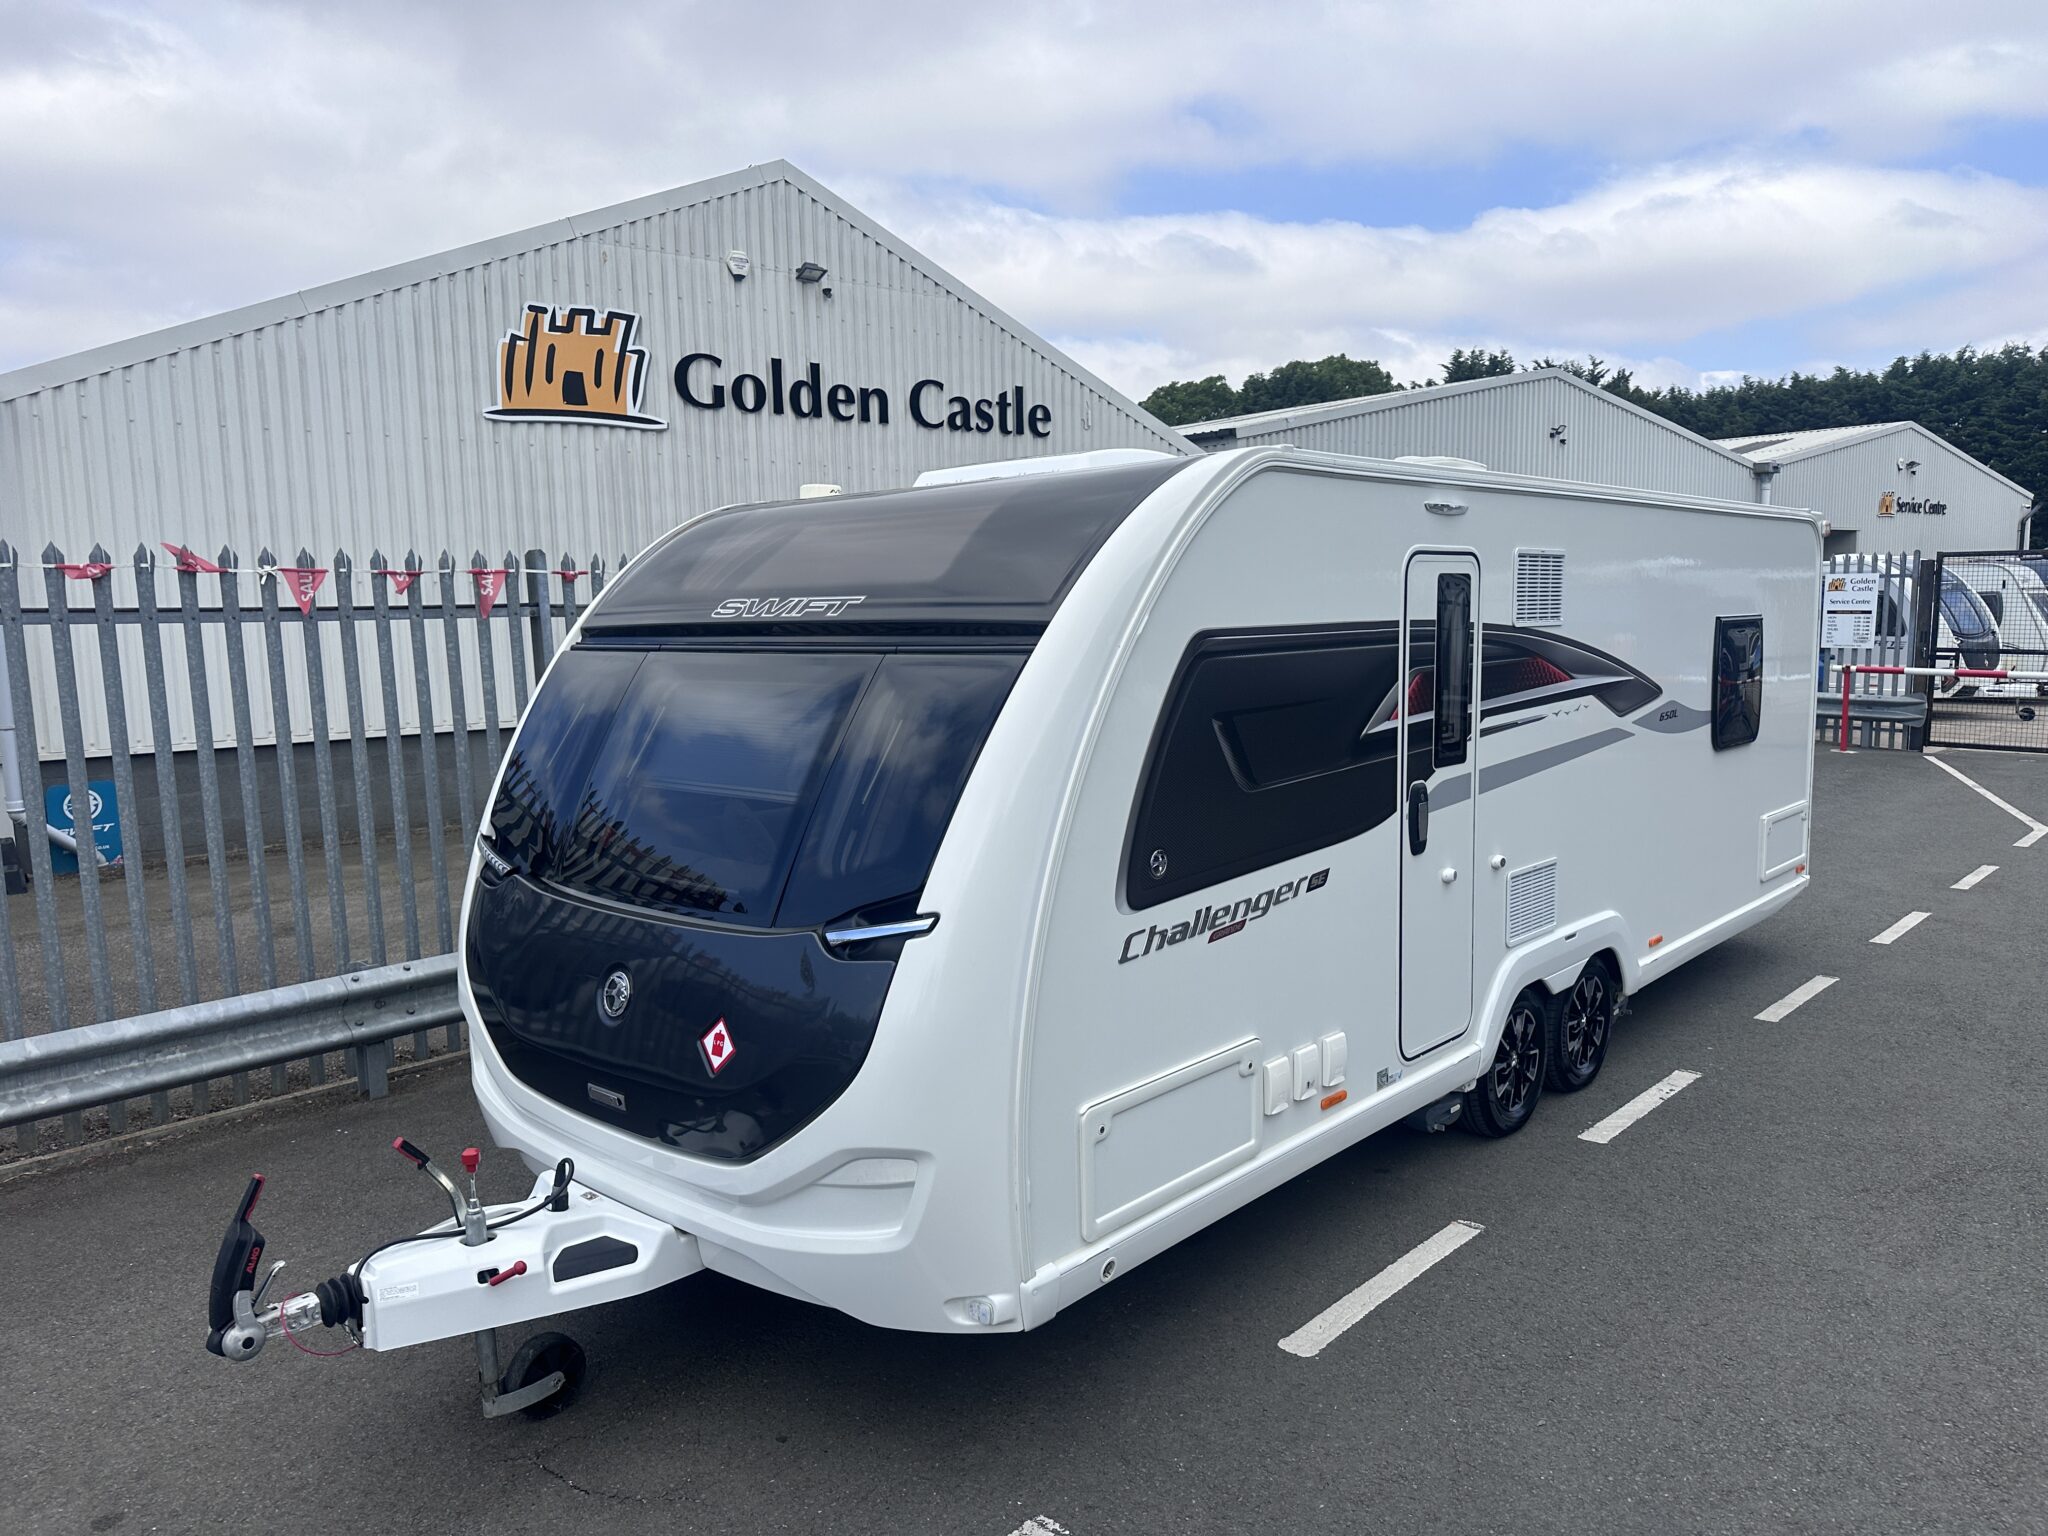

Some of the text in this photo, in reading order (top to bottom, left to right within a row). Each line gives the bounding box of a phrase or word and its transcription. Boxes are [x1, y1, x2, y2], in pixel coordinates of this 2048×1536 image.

[674, 353, 1053, 438] Golden Castle
[1896, 497, 1947, 515] Service Centre
[1850, 577, 1877, 585] Golden
[711, 595, 867, 618] SWIFT
[1659, 709, 1678, 721] 650L
[1118, 876, 1308, 964] Challenger
